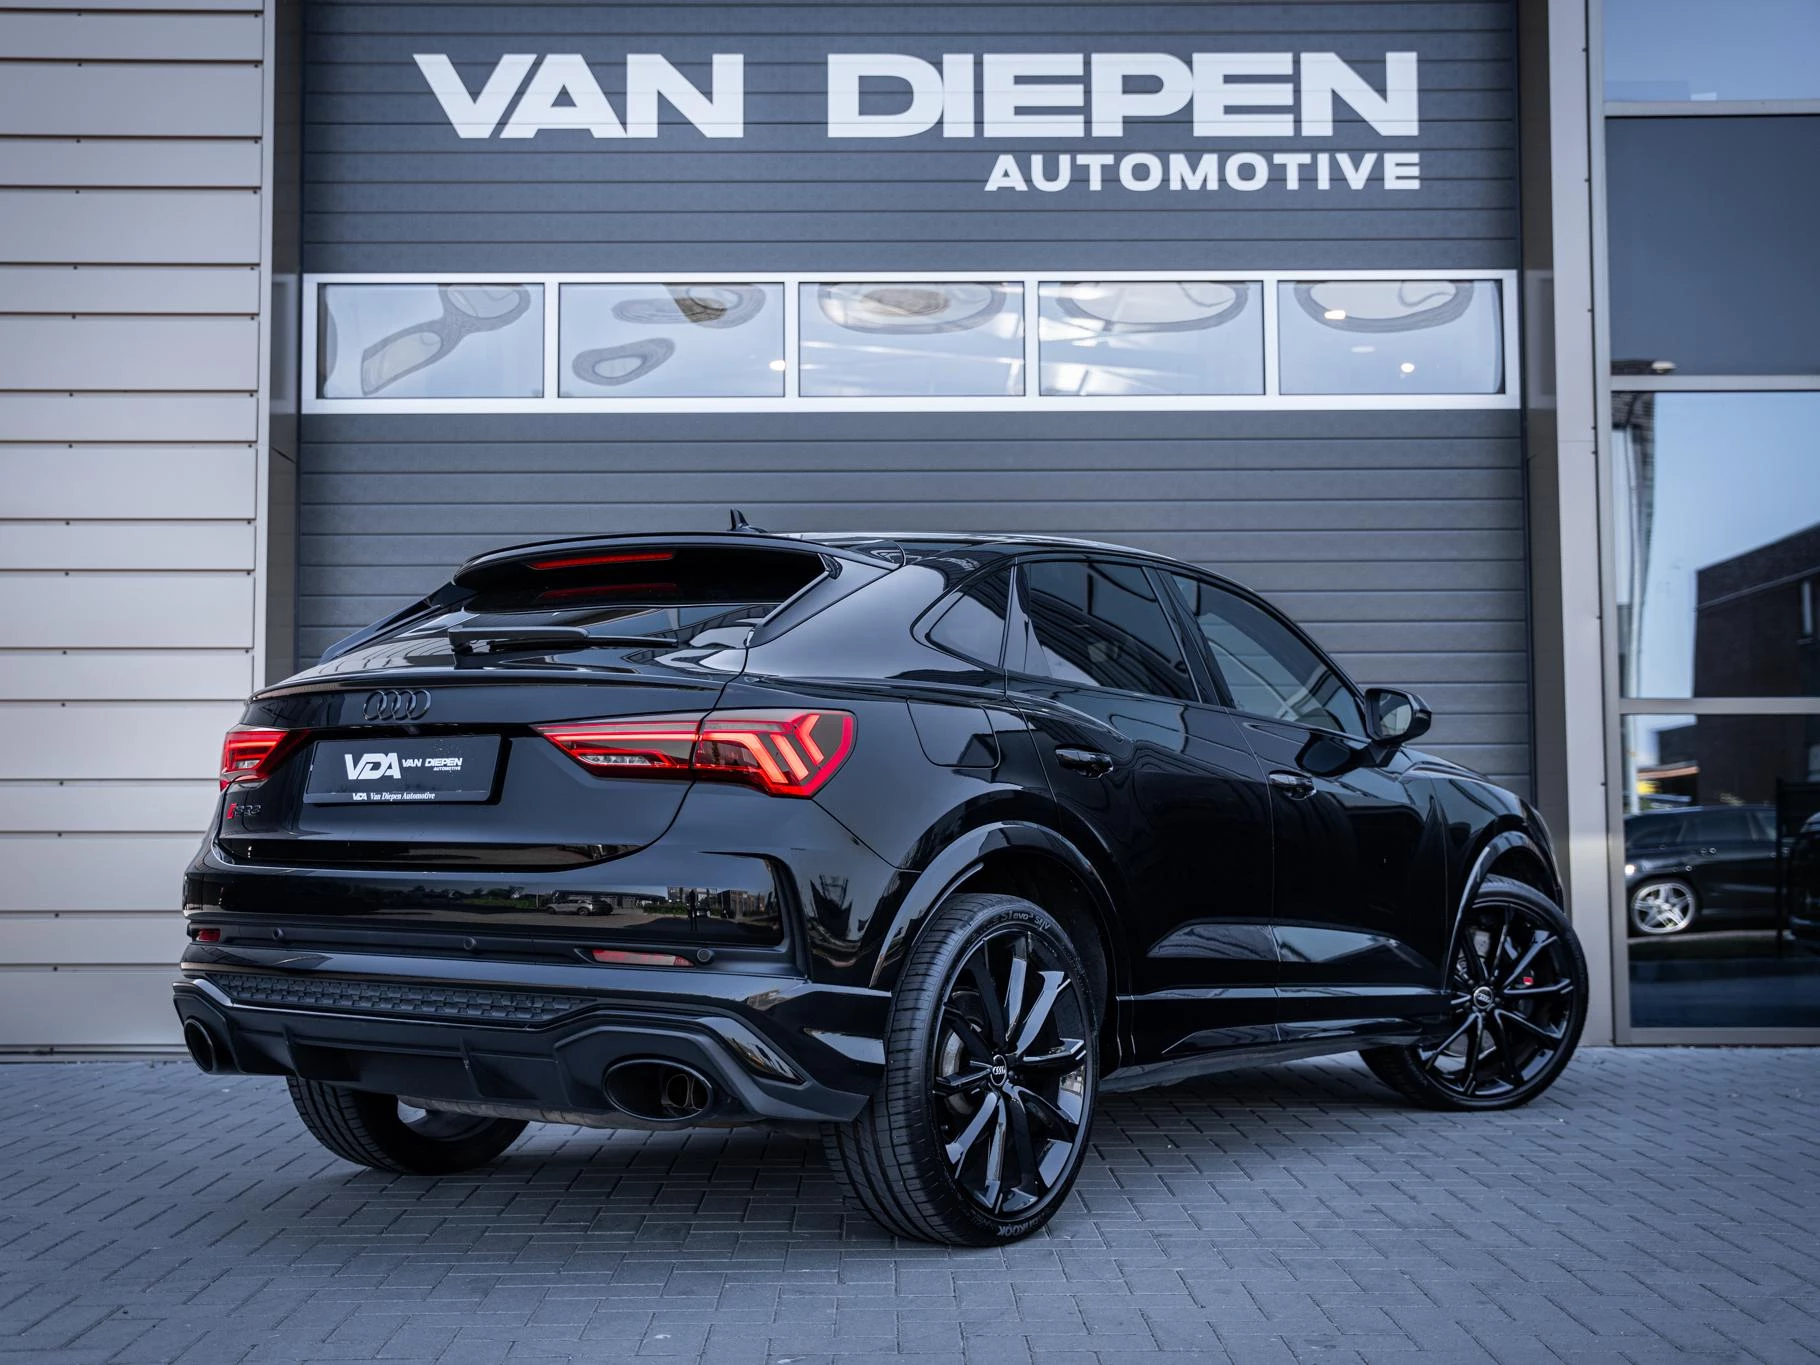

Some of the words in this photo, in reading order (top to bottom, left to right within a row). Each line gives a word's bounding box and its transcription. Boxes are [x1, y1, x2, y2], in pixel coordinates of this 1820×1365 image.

[412, 53, 745, 139] VAN
[827, 52, 1419, 138] DIEPEN
[984, 152, 1421, 192] AUTOMOTIVE
[344, 752, 402, 780] VDA
[402, 758, 422, 767] VAN
[425, 757, 463, 767] DIEPEN
[370, 792, 381, 800] Van
[382, 792, 400, 801] Diepen
[402, 791, 435, 800] Automotive
